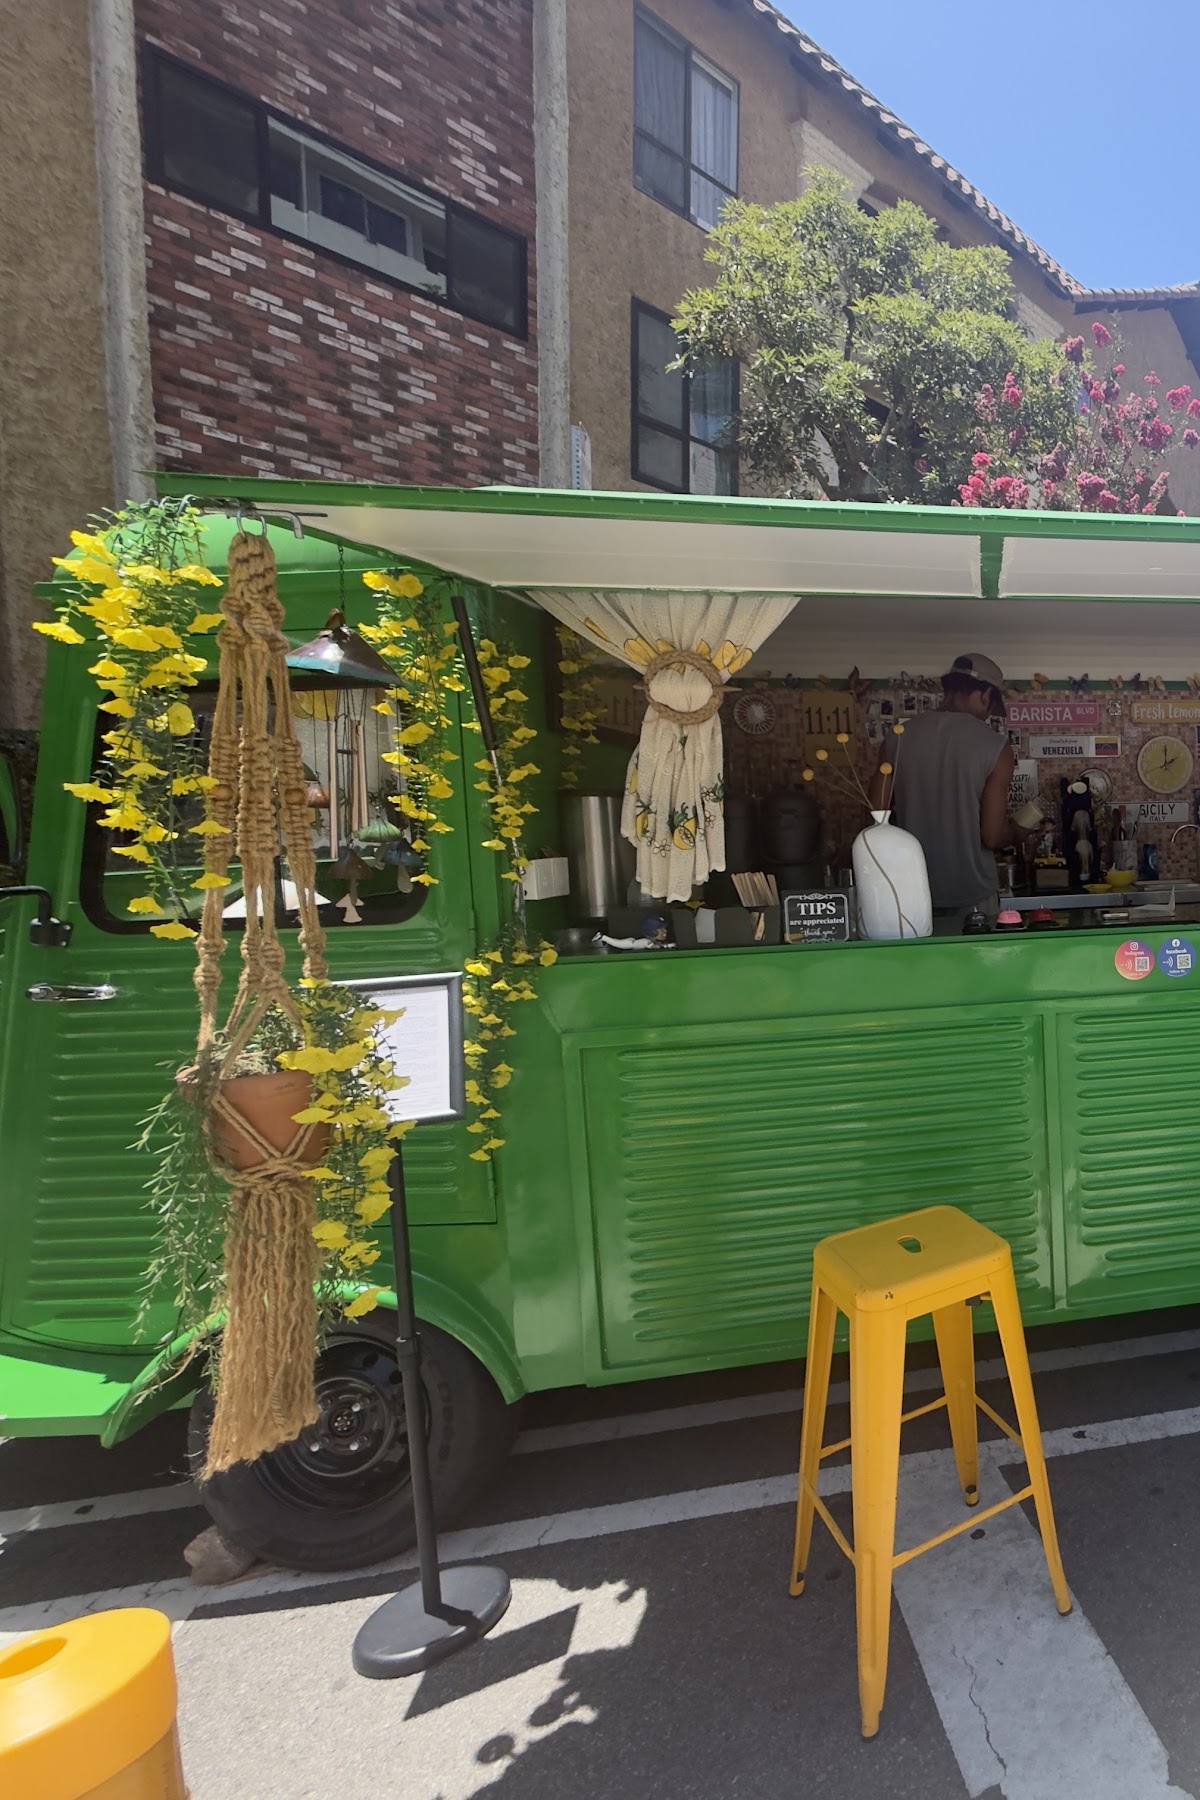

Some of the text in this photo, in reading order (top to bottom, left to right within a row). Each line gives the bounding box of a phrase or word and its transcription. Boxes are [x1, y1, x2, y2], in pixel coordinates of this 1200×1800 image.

[1010, 706, 1095, 721] BARISTA BLVD
[1132, 703, 1165, 719] Fresh
[804, 706, 852, 735] 11:11
[1042, 746, 1084, 756] VENEZUELA
[1140, 804, 1176, 816] SICILY
[796, 901, 836, 916] TIPS
[802, 916, 845, 926] appreciated
